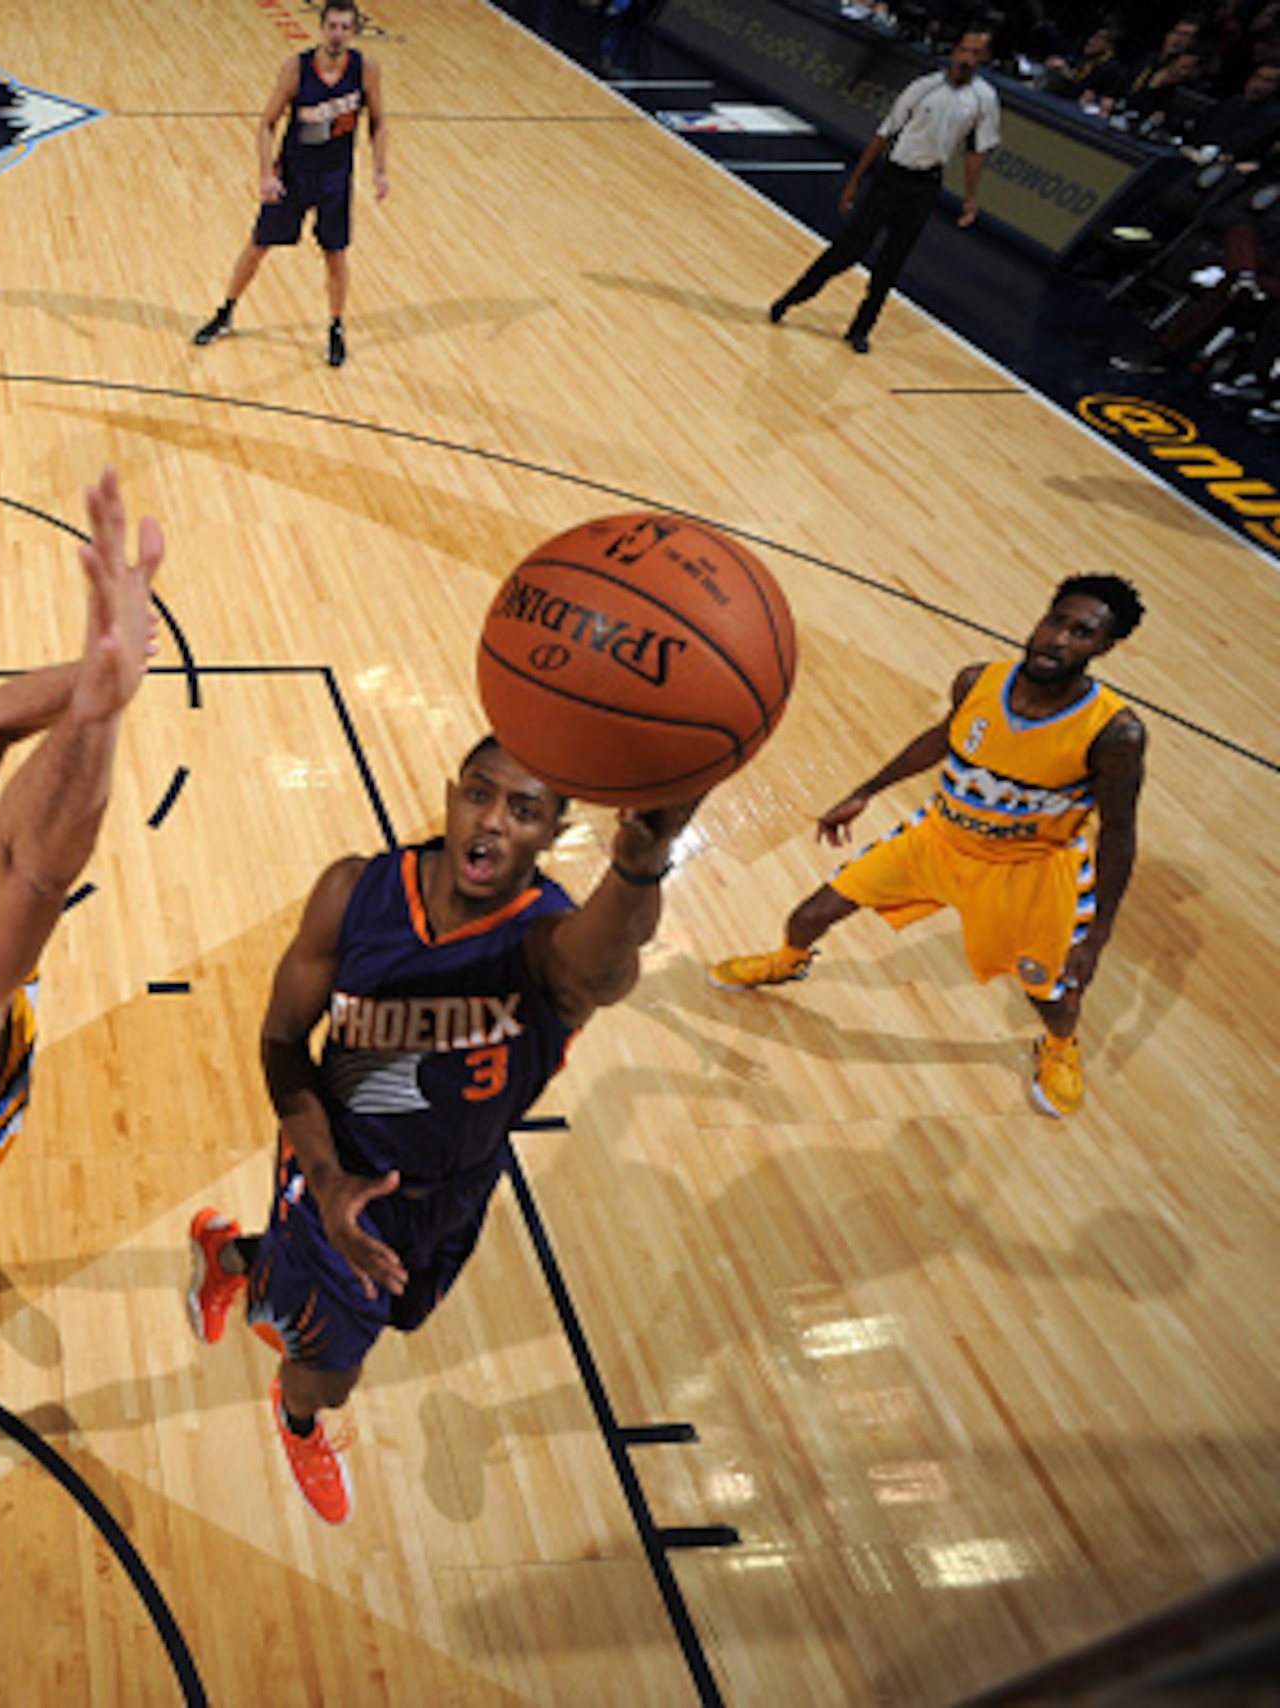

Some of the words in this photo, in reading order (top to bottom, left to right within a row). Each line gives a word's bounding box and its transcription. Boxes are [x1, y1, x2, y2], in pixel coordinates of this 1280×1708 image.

[986, 148, 1099, 216] RDWOOD
[330, 991, 523, 1052] PHOENIX
[461, 1044, 509, 1103] 3
